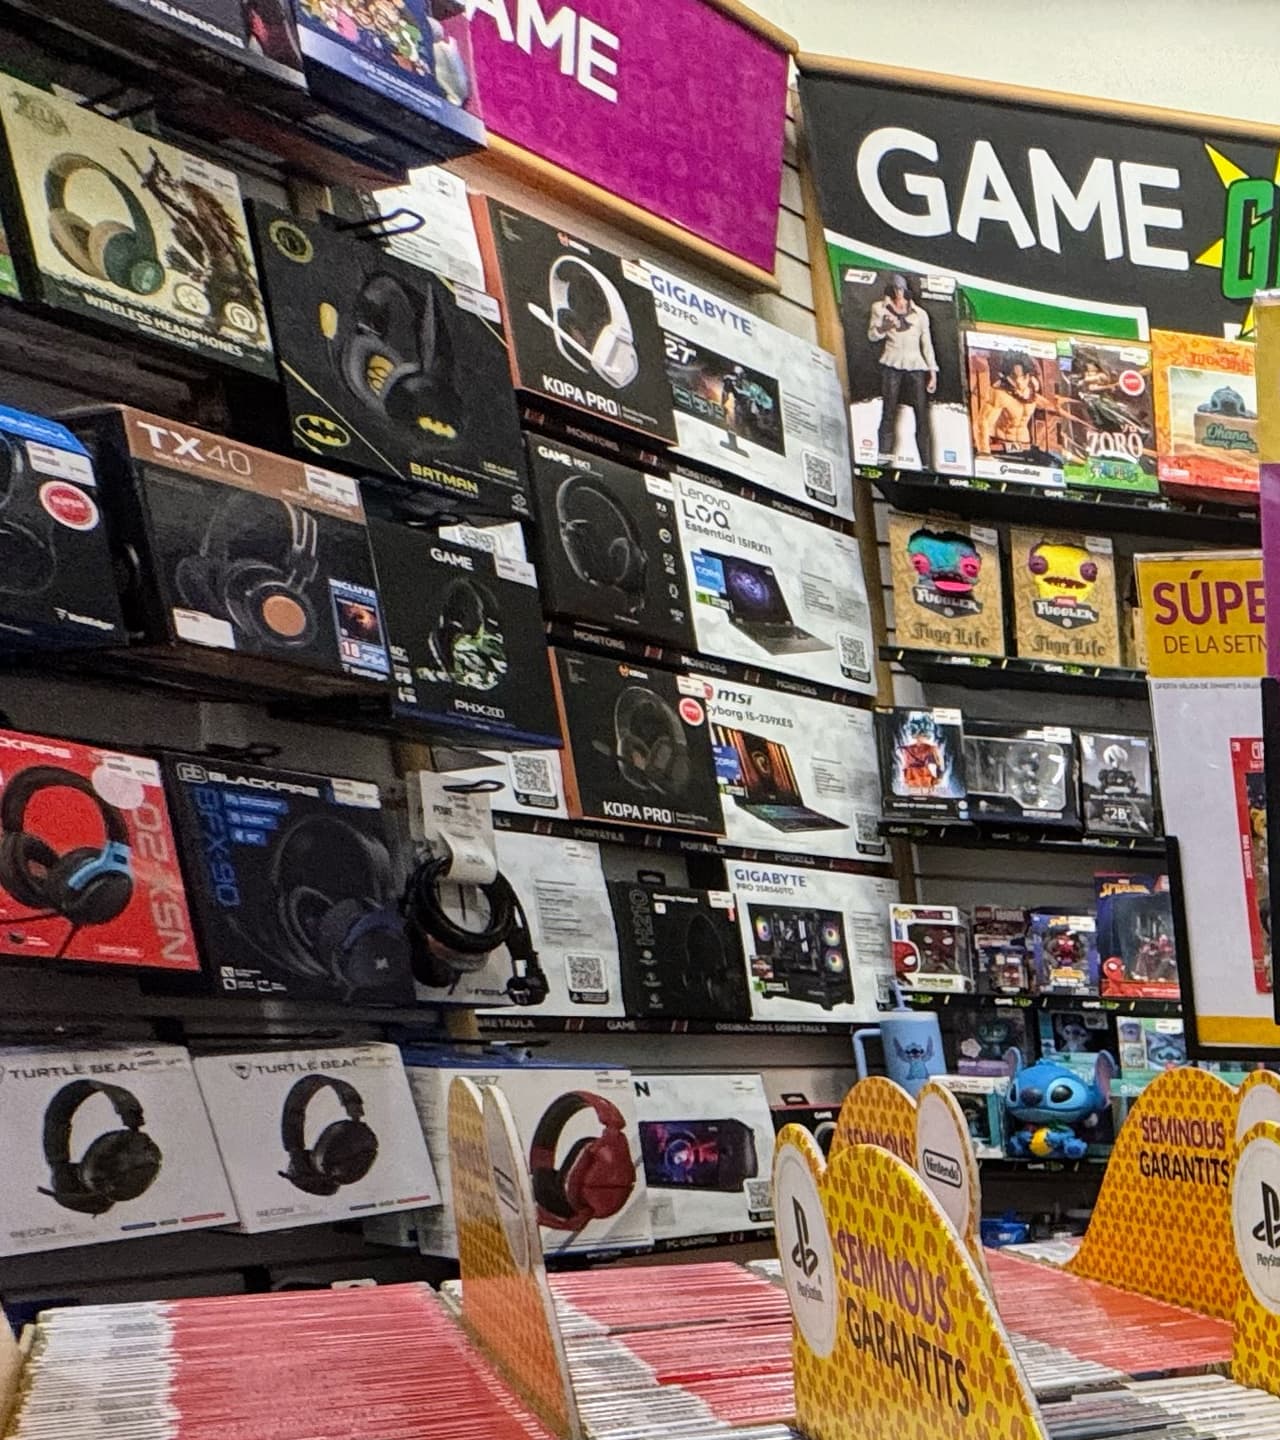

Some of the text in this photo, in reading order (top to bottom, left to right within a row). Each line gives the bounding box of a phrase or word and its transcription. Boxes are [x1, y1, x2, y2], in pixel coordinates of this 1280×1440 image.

[856, 126, 1190, 271] GAME
[651, 274, 753, 337] GIGABYTE
[84, 293, 243, 357] WIRELESS HEADPHONES
[543, 375, 617, 417] KOPA PRO
[410, 462, 480, 495] BATMAN
[679, 482, 730, 512] Lenovo
[683, 503, 731, 532] LOQ
[685, 519, 736, 546] Essential
[430, 548, 473, 570] GAME
[330, 578, 376, 598] INCLUYE
[573, 629, 626, 650] MONITORS
[1164, 635, 1189, 654] DE
[1196, 635, 1219, 653] LA
[717, 686, 753, 705] msi
[209, 770, 319, 797] BLACKFIRE
[734, 867, 808, 888] GIGABYTE
[9, 1066, 80, 1081] TURTLE
[1141, 1117, 1226, 1149] SEMINOUS
[925, 1154, 962, 1184] Nintendo
[1139, 1150, 1231, 1187] GARANTITS
[838, 1230, 954, 1334] SEMINOUS
[846, 1298, 972, 1417] GARANTITS
